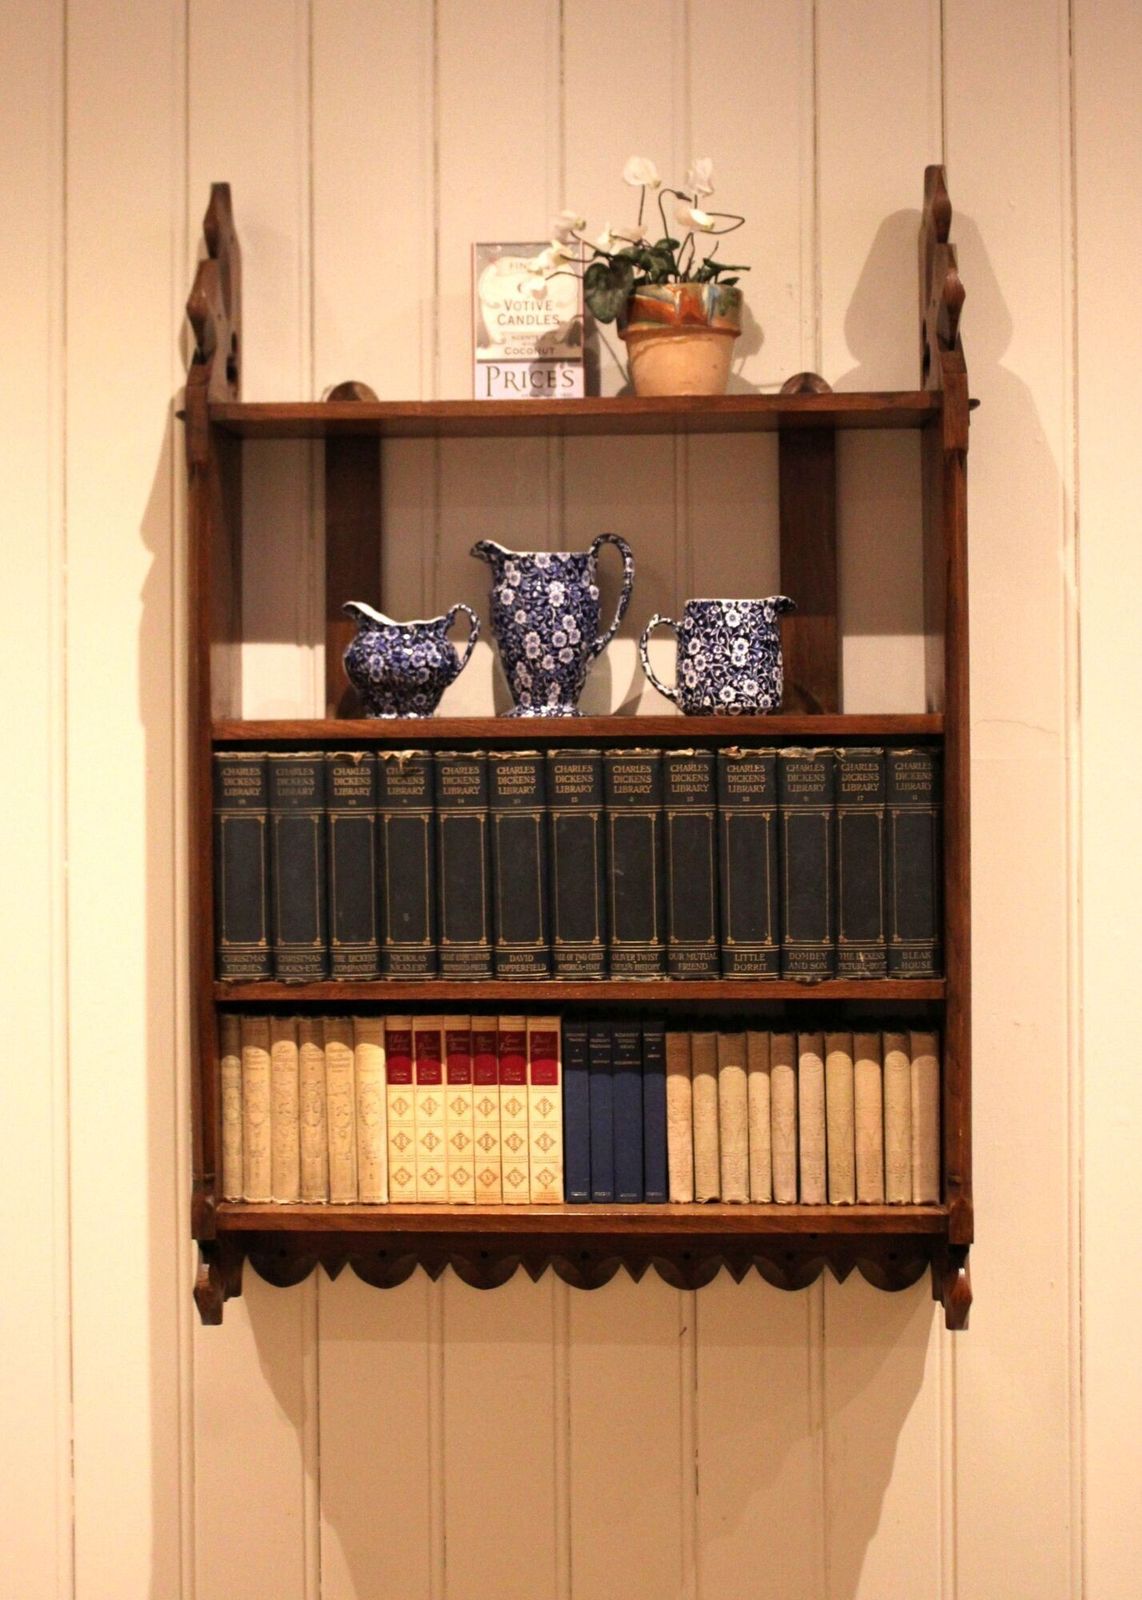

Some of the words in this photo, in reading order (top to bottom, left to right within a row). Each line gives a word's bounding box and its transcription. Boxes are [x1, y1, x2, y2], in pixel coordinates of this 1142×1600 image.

[504, 300, 552, 311] VOTIVE
[497, 314, 560, 325] CANDLES
[504, 347, 555, 355] COCONUT
[442, 767, 479, 775] CHARLES
[497, 766, 535, 774] CHARLES
[555, 765, 593, 773] CHARLES
[613, 765, 651, 773] CHARLES
[670, 764, 709, 772] CHARLES
[727, 764, 765, 773] CHARLES
[786, 764, 824, 772] CHARLES
[841, 763, 879, 771] CHARLES
[333, 768, 371, 776] CHARLES
[334, 777, 371, 785] DICKENS
[442, 776, 480, 785] DICKENS
[497, 776, 536, 785] DICKENS
[555, 775, 593, 783] DICKENS
[614, 775, 652, 783] DICKENS
[671, 774, 709, 782] DICKENS
[728, 774, 766, 783] DICKENS
[787, 774, 825, 782] DICKENS
[842, 773, 879, 781] DICKENS
[334, 787, 371, 796] LIBRARY
[443, 786, 480, 795] LIBRARY
[498, 786, 536, 795] LIBRARY
[556, 785, 593, 793] LIBRARY
[614, 785, 652, 794] LIBRARY
[672, 784, 709, 792] LIBRARY
[728, 784, 766, 793] LIBRARY
[788, 784, 825, 792] LIBRARY
[842, 783, 879, 792] LIBRARY
[637, 953, 659, 961] TWIST
[668, 953, 684, 961] OUR
[735, 954, 765, 962] LITTLE
[789, 952, 827, 960] DOMBEY
[902, 951, 932, 959] BLEAK
[497, 964, 546, 972] COPPERFIELD
[678, 962, 708, 970] FRIEND
[734, 963, 767, 971] DORRIT
[788, 962, 807, 970] AND
[809, 962, 827, 970] SON
[901, 961, 933, 969] HOUSE
